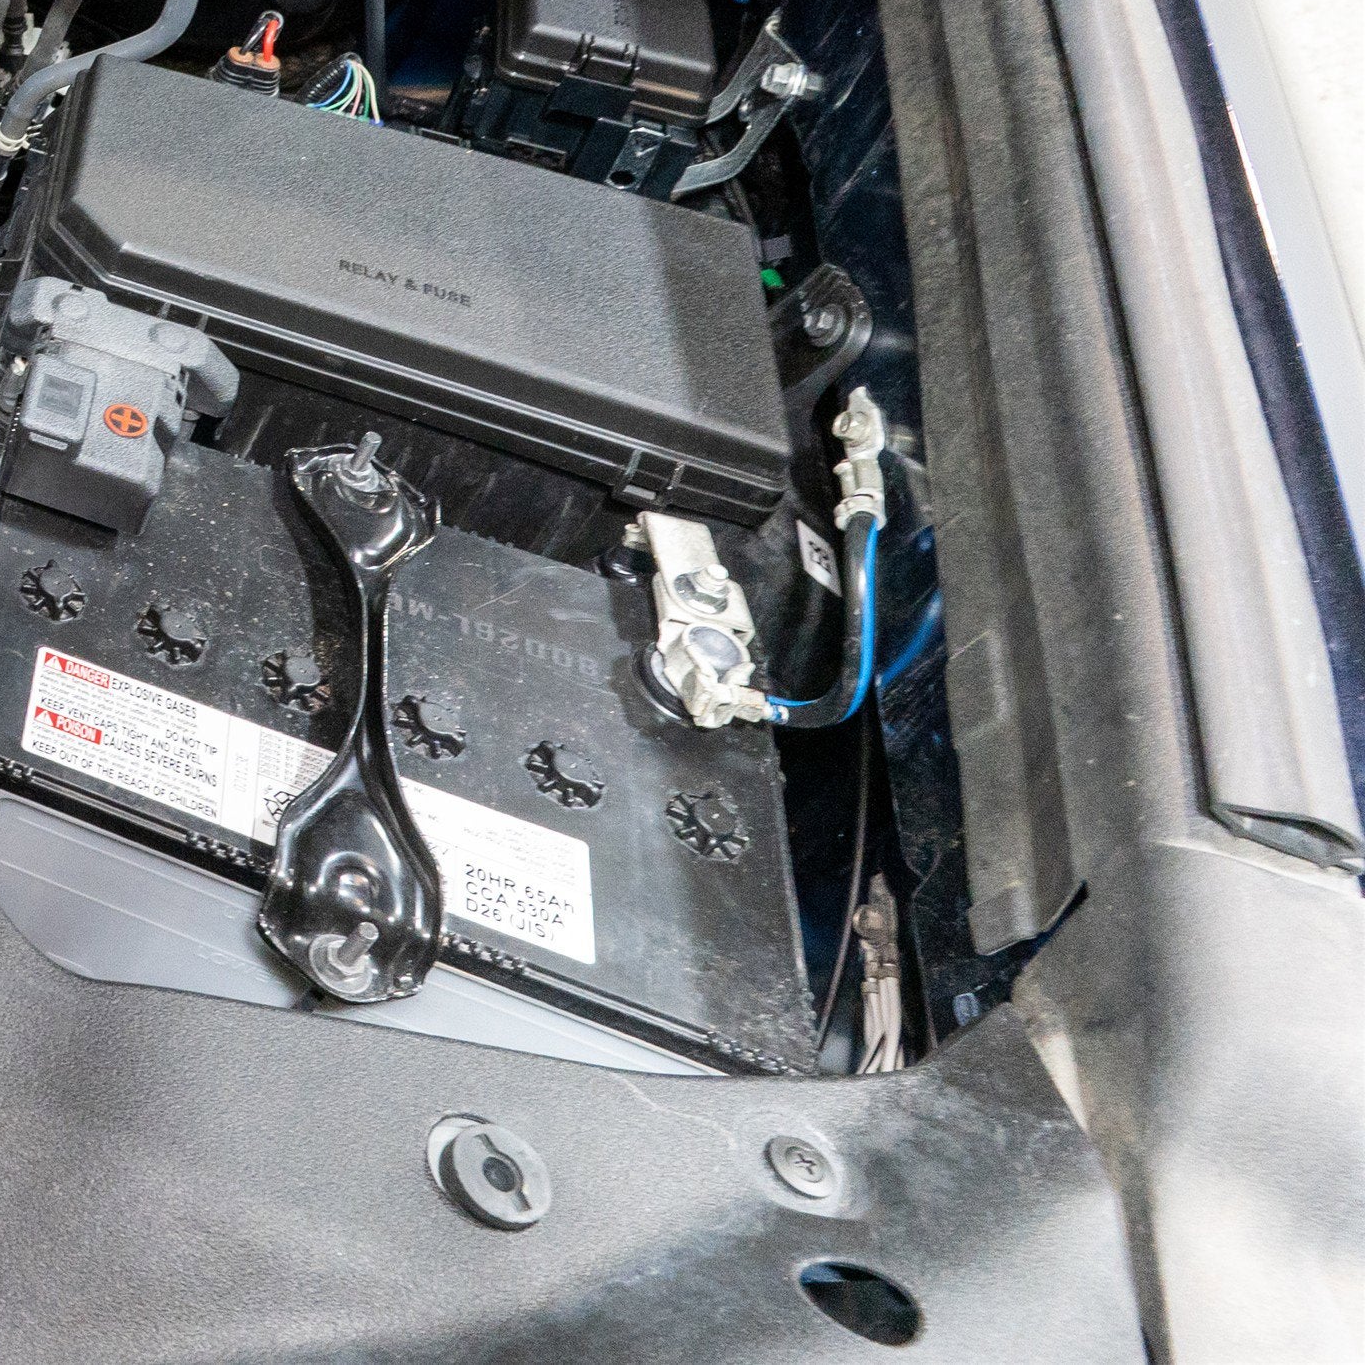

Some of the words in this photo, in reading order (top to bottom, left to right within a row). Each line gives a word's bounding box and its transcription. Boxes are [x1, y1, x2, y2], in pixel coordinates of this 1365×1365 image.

[339, 259, 399, 284] RELAY
[404, 278, 418, 291] &
[423, 283, 471, 307] FUSE
[64, 661, 109, 686] DANGER
[111, 678, 162, 707] EXPLOSIVE
[166, 698, 197, 719] GASES
[41, 697, 64, 711] KEEP
[68, 707, 91, 722] VENT
[94, 716, 118, 733] CAPS
[121, 726, 148, 745] TIGHT
[151, 737, 170, 752] AND
[173, 746, 203, 765] LEVEL
[55, 715, 97, 742] POISON
[103, 734, 141, 758] CAUSES
[144, 749, 181, 773] SEVERE
[185, 765, 218, 787] BURNS
[166, 729, 179, 742] DO
[181, 735, 202, 751] NOT
[204, 743, 218, 755] TIP
[32, 740, 57, 755] KEEP
[60, 750, 79, 766] OUT
[81, 759, 94, 769] OF
[97, 764, 114, 779] THE
[118, 772, 150, 792] REACH
[153, 785, 166, 798] OF
[169, 792, 218, 819] CHILDREN
[465, 864, 516, 893] 20HR
[525, 886, 575, 914] 65Ah
[466, 881, 508, 907] CCA
[517, 900, 565, 928] 530A
[466, 898, 502, 922] D26
[510, 914, 554, 941] (JIS)
